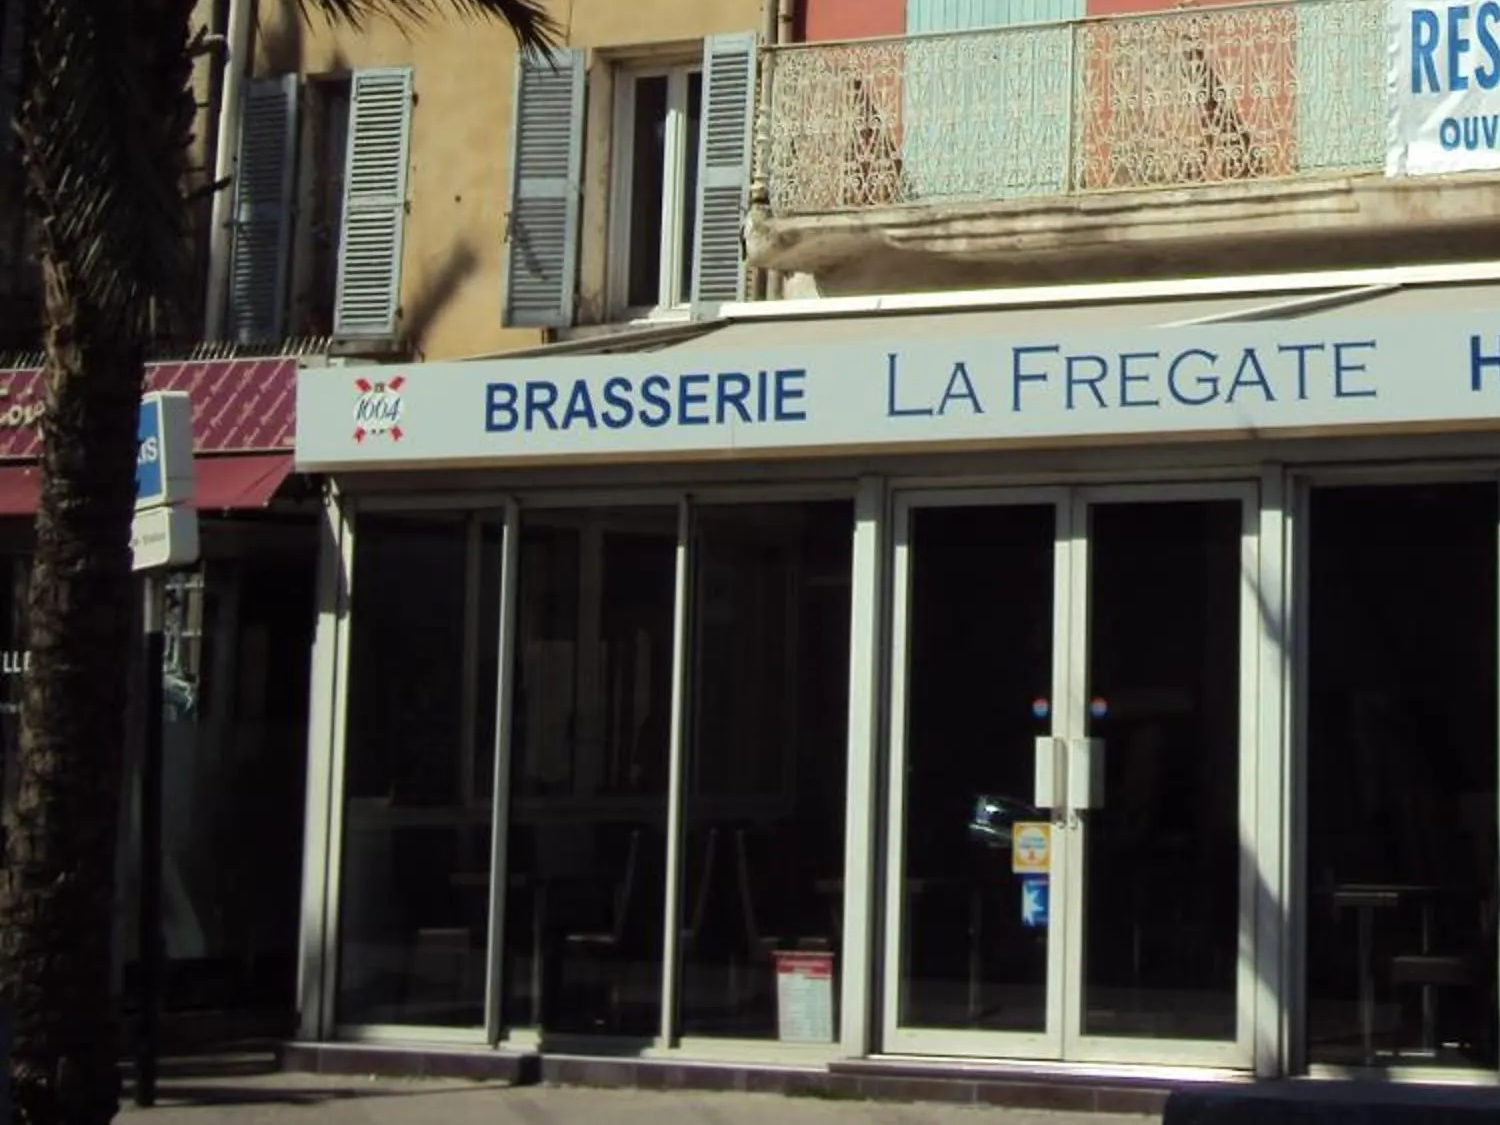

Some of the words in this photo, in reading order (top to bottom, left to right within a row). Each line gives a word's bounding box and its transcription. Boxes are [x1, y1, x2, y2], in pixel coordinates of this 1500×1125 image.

[484, 368, 807, 434] BRASSERIE
[886, 352, 984, 418] LA
[1011, 340, 1378, 413] FREGATE
